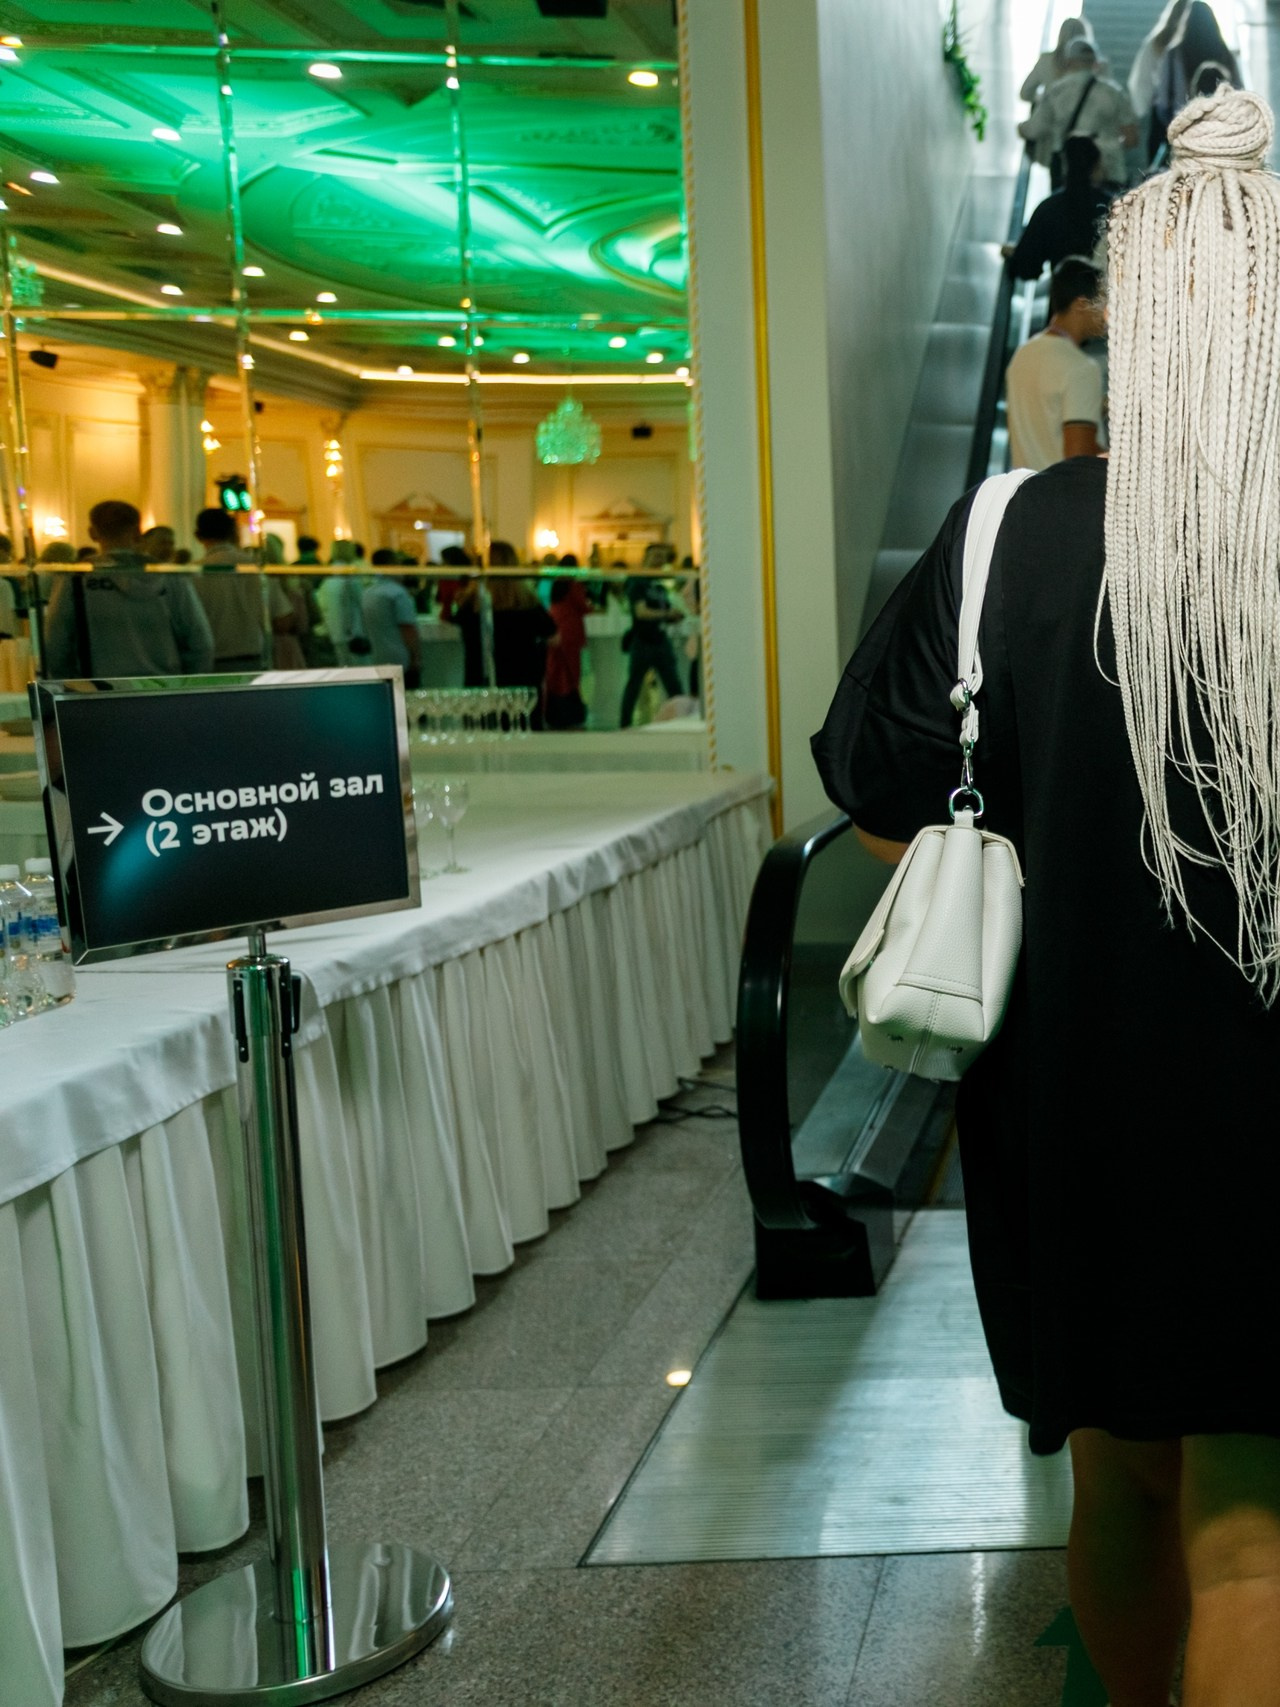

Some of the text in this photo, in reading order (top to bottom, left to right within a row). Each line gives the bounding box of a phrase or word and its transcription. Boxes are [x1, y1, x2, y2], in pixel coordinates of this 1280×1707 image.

[141, 772, 384, 817] Основной зал
[145, 807, 288, 857] (2 этаж)
